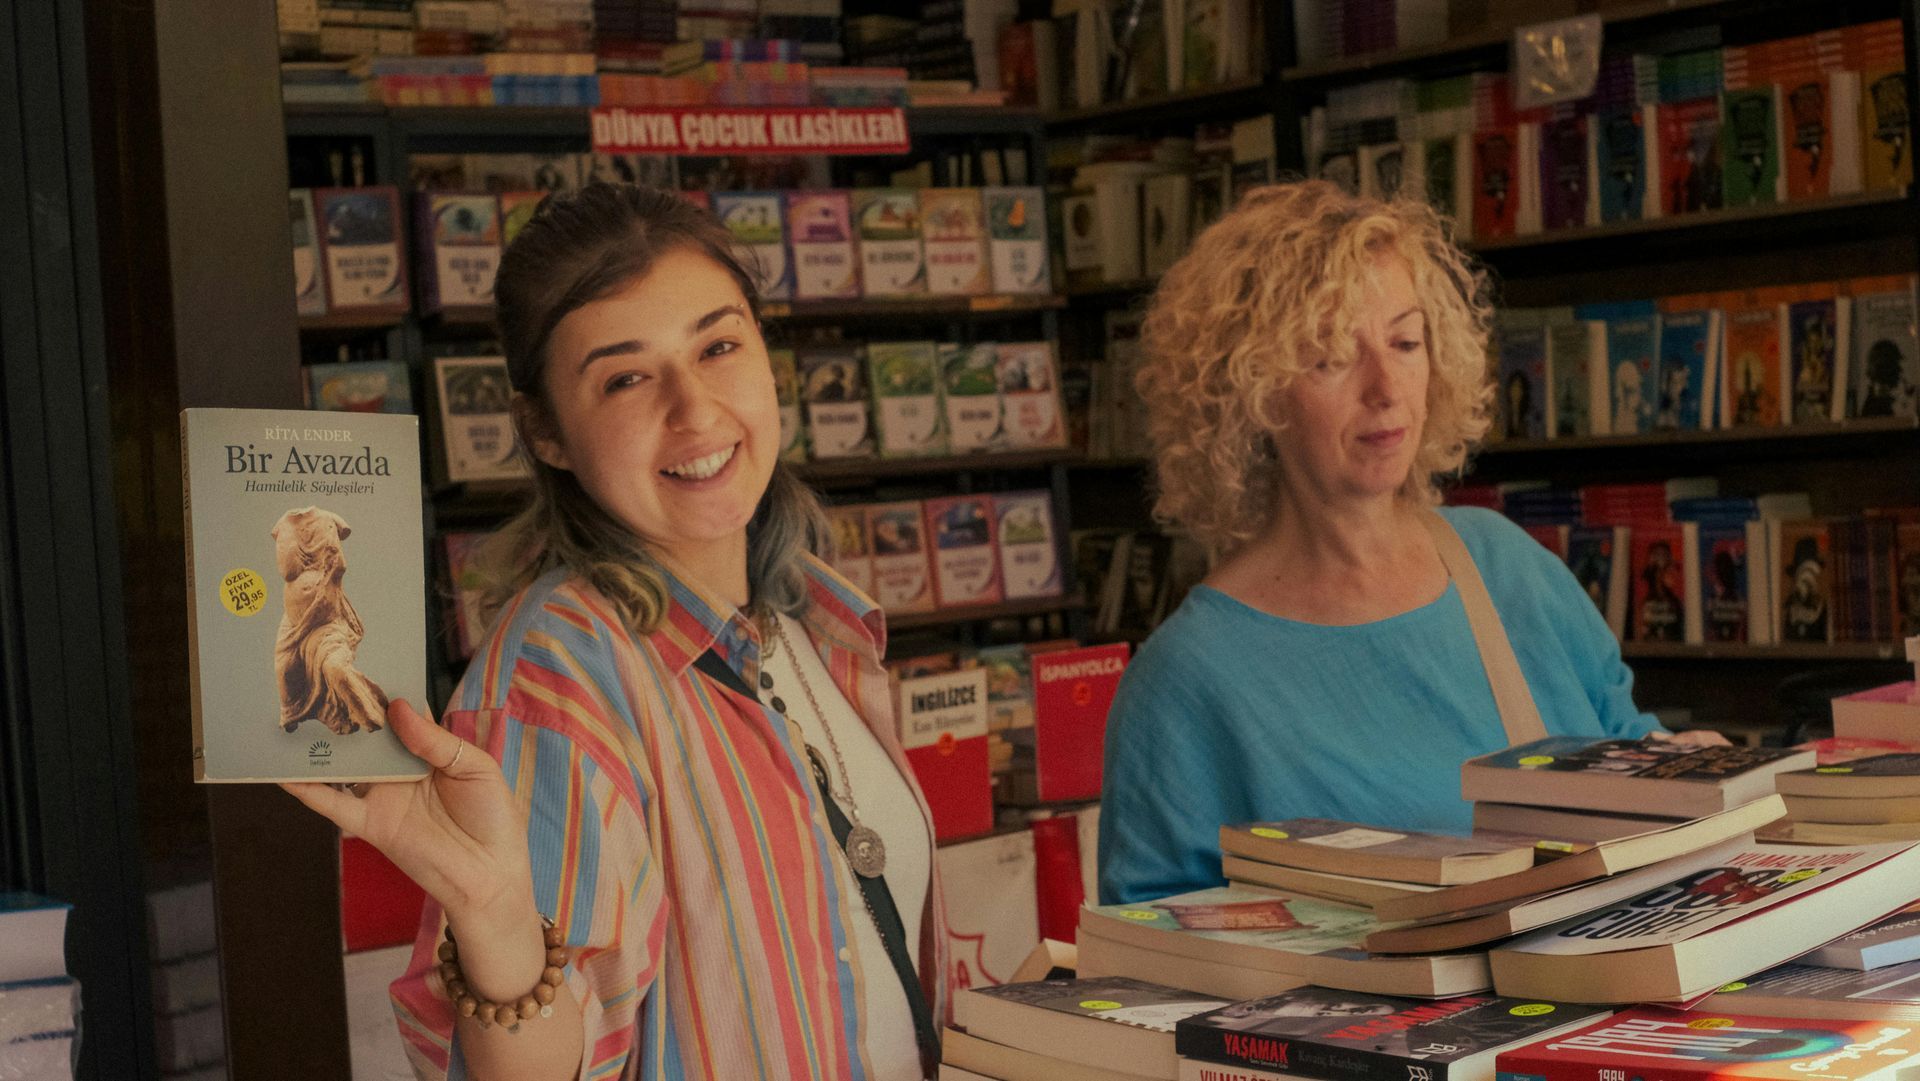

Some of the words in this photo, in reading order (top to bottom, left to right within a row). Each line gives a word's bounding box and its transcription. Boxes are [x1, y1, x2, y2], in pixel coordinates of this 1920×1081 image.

[593, 108, 679, 147] DÜNYA
[680, 113, 768, 152] ÇOCUK
[770, 107, 908, 146] KLASİKLERİ
[265, 425, 300, 441] RİTA
[304, 428, 353, 442] ENDER
[224, 444, 273, 474] Bir
[282, 446, 391, 477] Avazda
[245, 479, 306, 493] Hamilelik
[310, 481, 375, 496] Söyleşileri
[225, 571, 250, 586] ÖZEL
[229, 578, 254, 596] FİYAT
[231, 589, 264, 611] 29,95
[1040, 657, 1124, 683] İSPANYOLCA
[911, 684, 976, 714] İNGİLİZCE
[1224, 1033, 1289, 1064] YAŞAMAK
